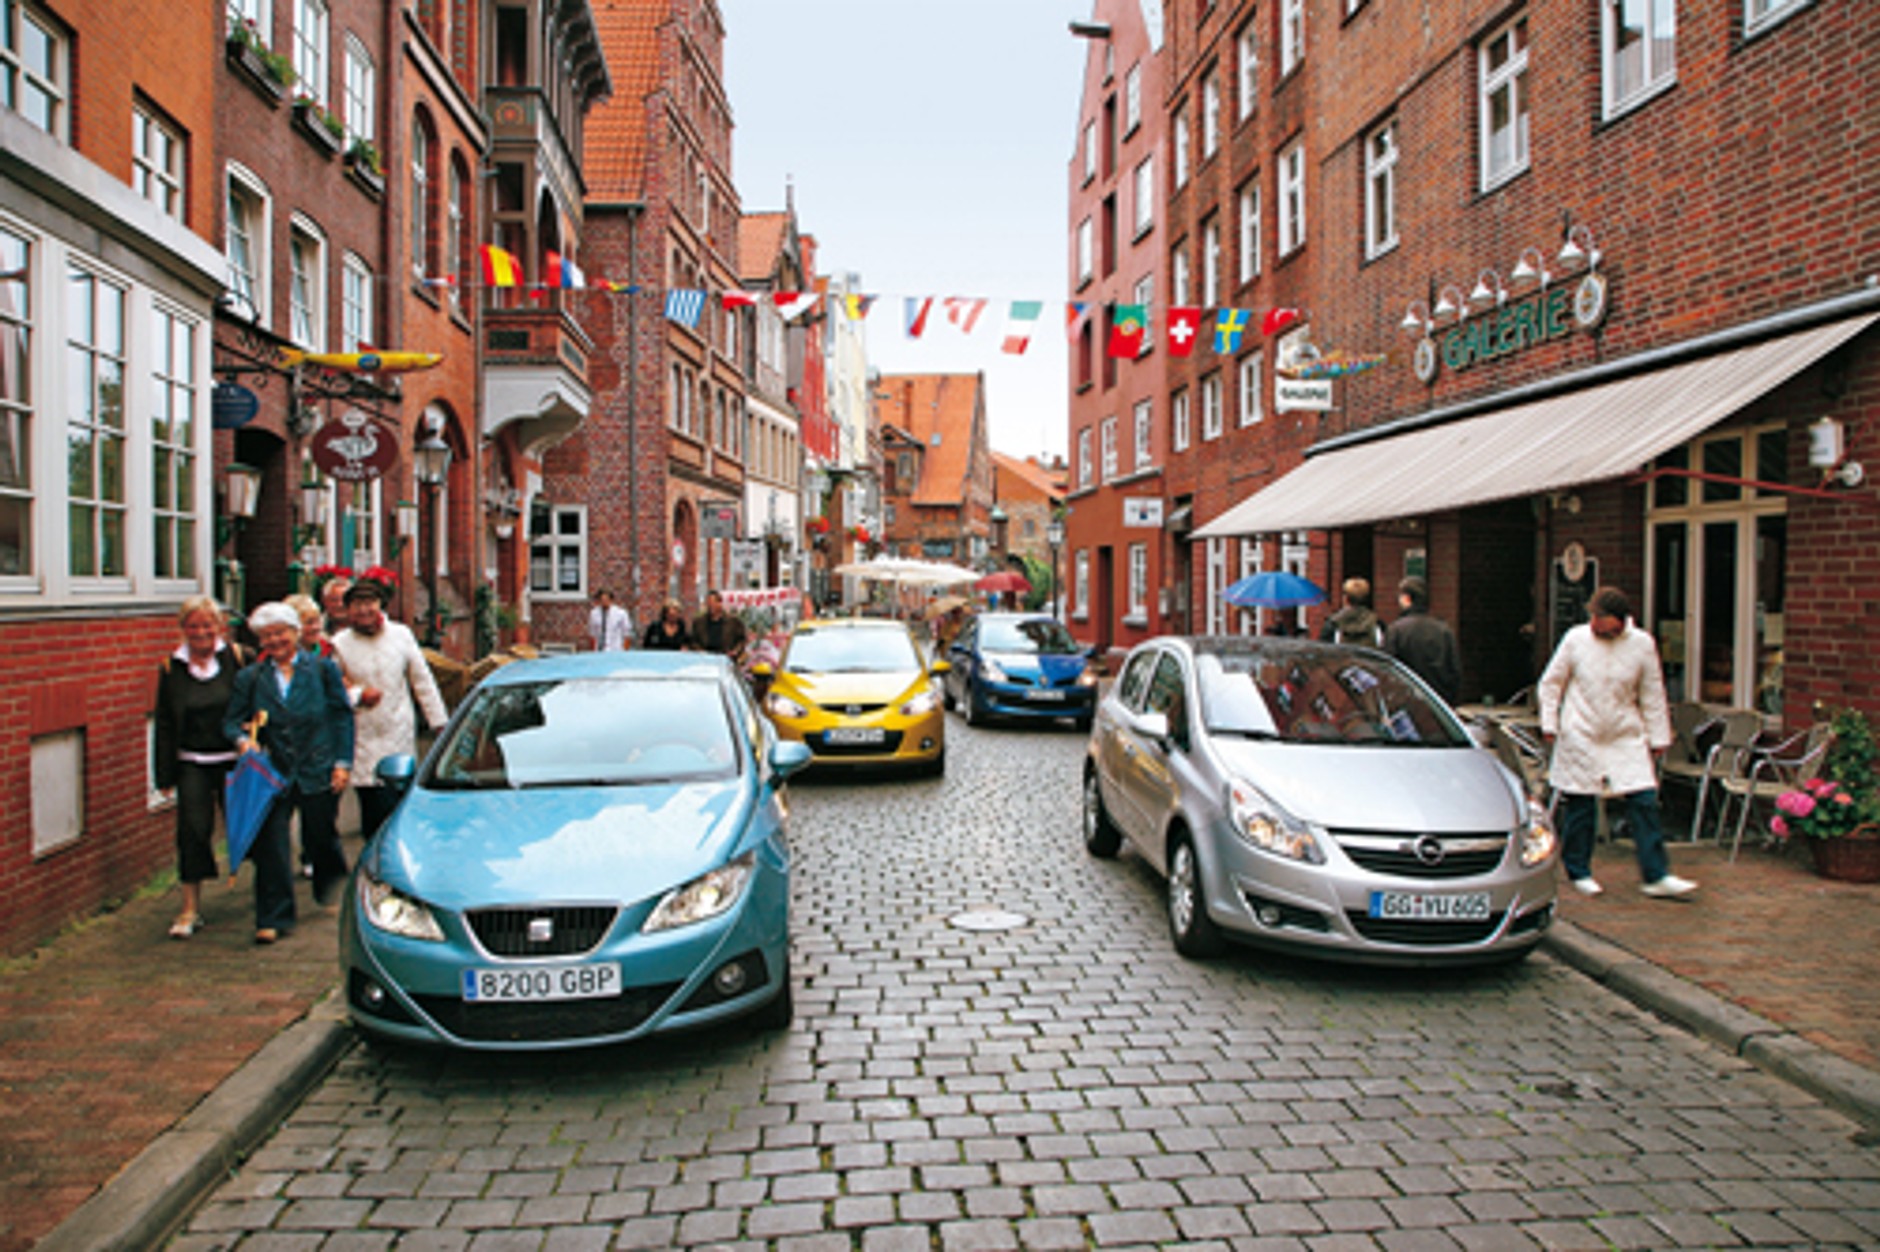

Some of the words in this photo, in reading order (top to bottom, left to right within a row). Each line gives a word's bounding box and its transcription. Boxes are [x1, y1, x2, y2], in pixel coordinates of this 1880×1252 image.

[1443, 289, 1568, 369] GALERIE
[481, 969, 551, 997] 8200
[560, 966, 614, 994] GBP
